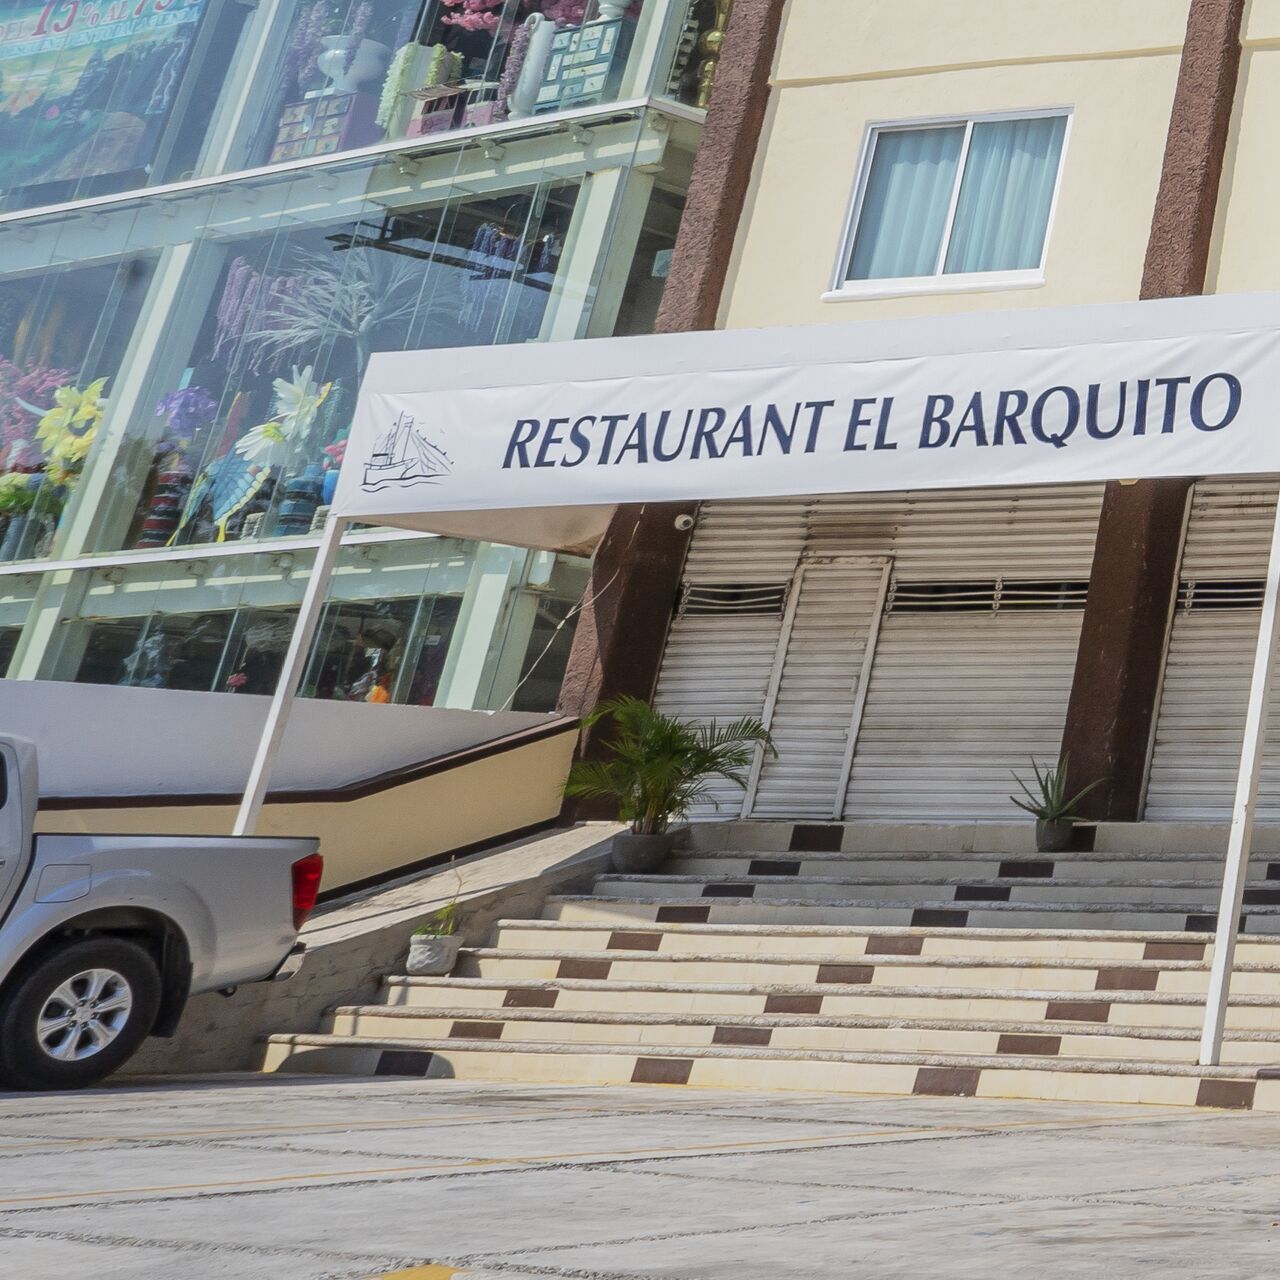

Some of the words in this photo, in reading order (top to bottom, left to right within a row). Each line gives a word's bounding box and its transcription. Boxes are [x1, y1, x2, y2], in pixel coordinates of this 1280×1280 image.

[501, 399, 835, 470] RESTAURANT
[843, 397, 898, 452] EL
[918, 372, 1243, 450] BARQUITO
